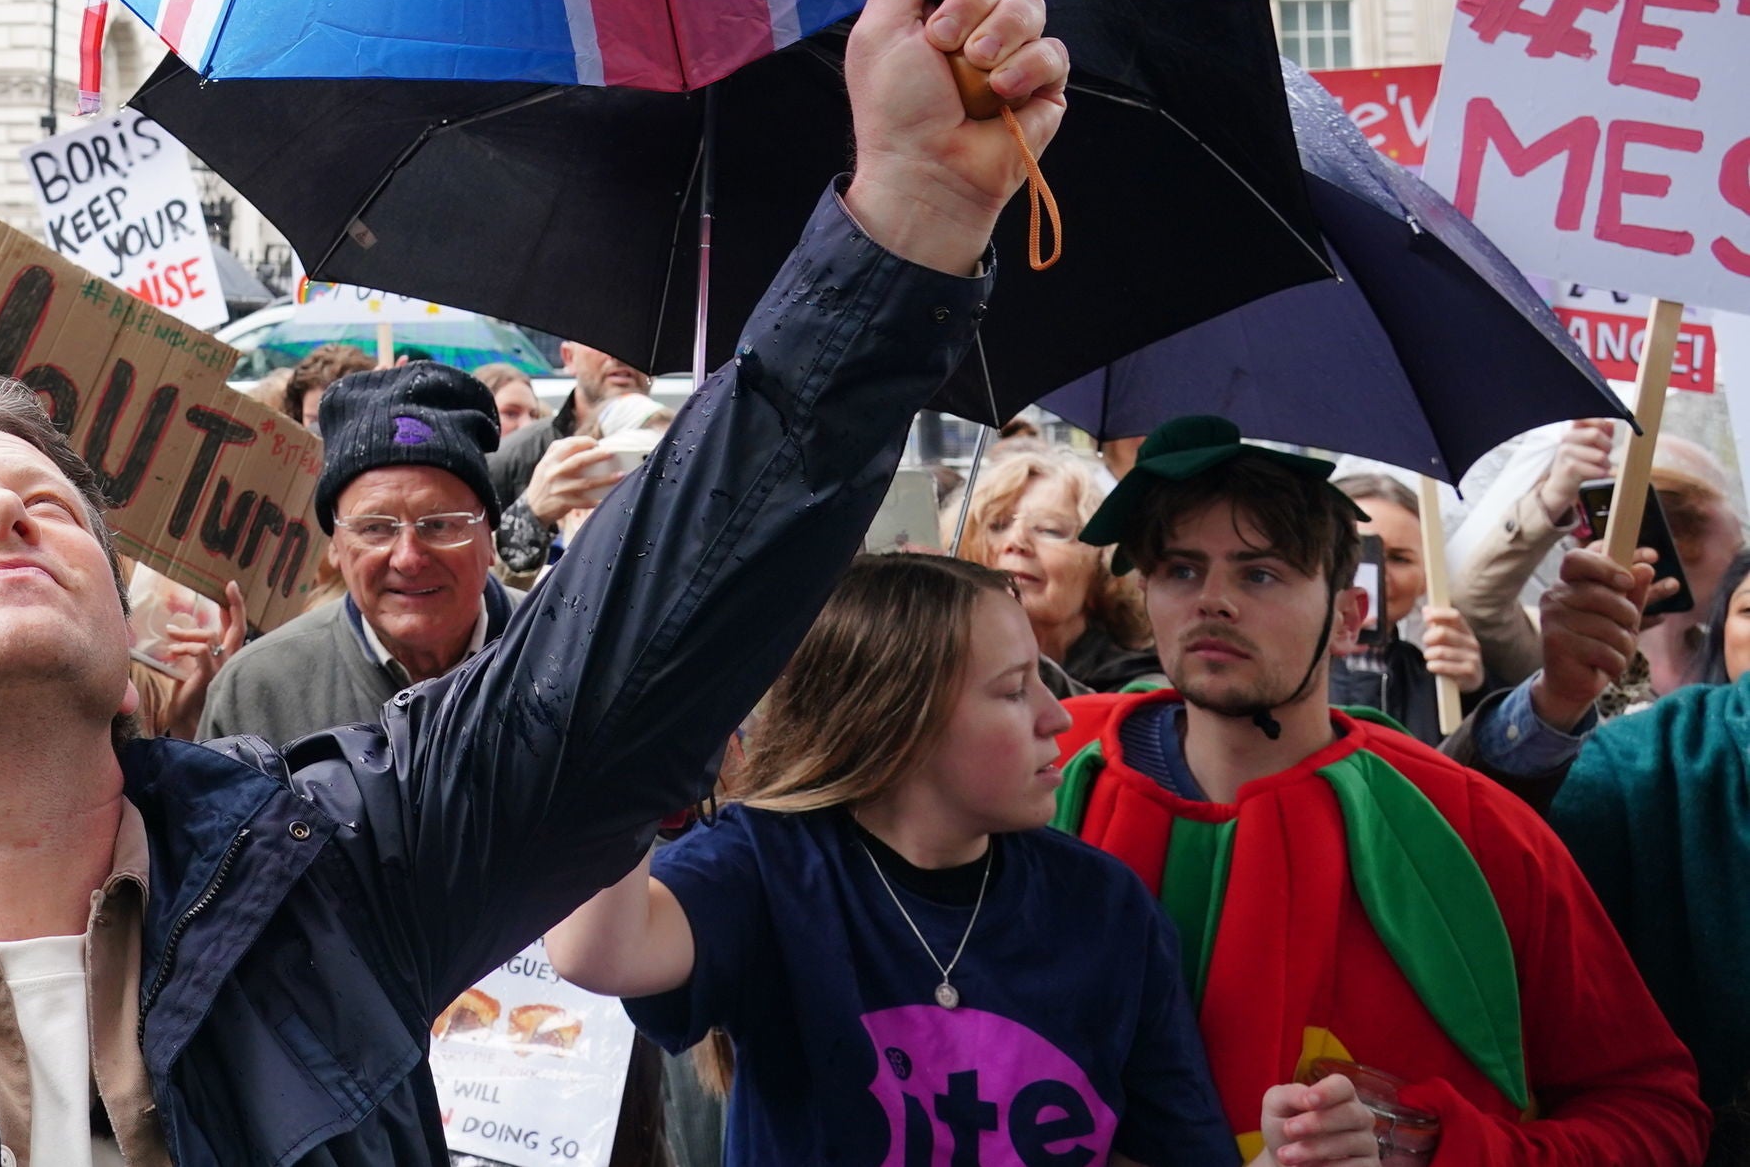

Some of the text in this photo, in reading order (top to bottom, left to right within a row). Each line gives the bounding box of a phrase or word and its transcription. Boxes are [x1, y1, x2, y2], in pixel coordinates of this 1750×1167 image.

[49, 187, 127, 255] KEEP
[85, 357, 180, 509] U
[454, 1080, 501, 1104] WILL
[462, 1116, 540, 1151] DOING
[550, 1135, 580, 1159] SO
